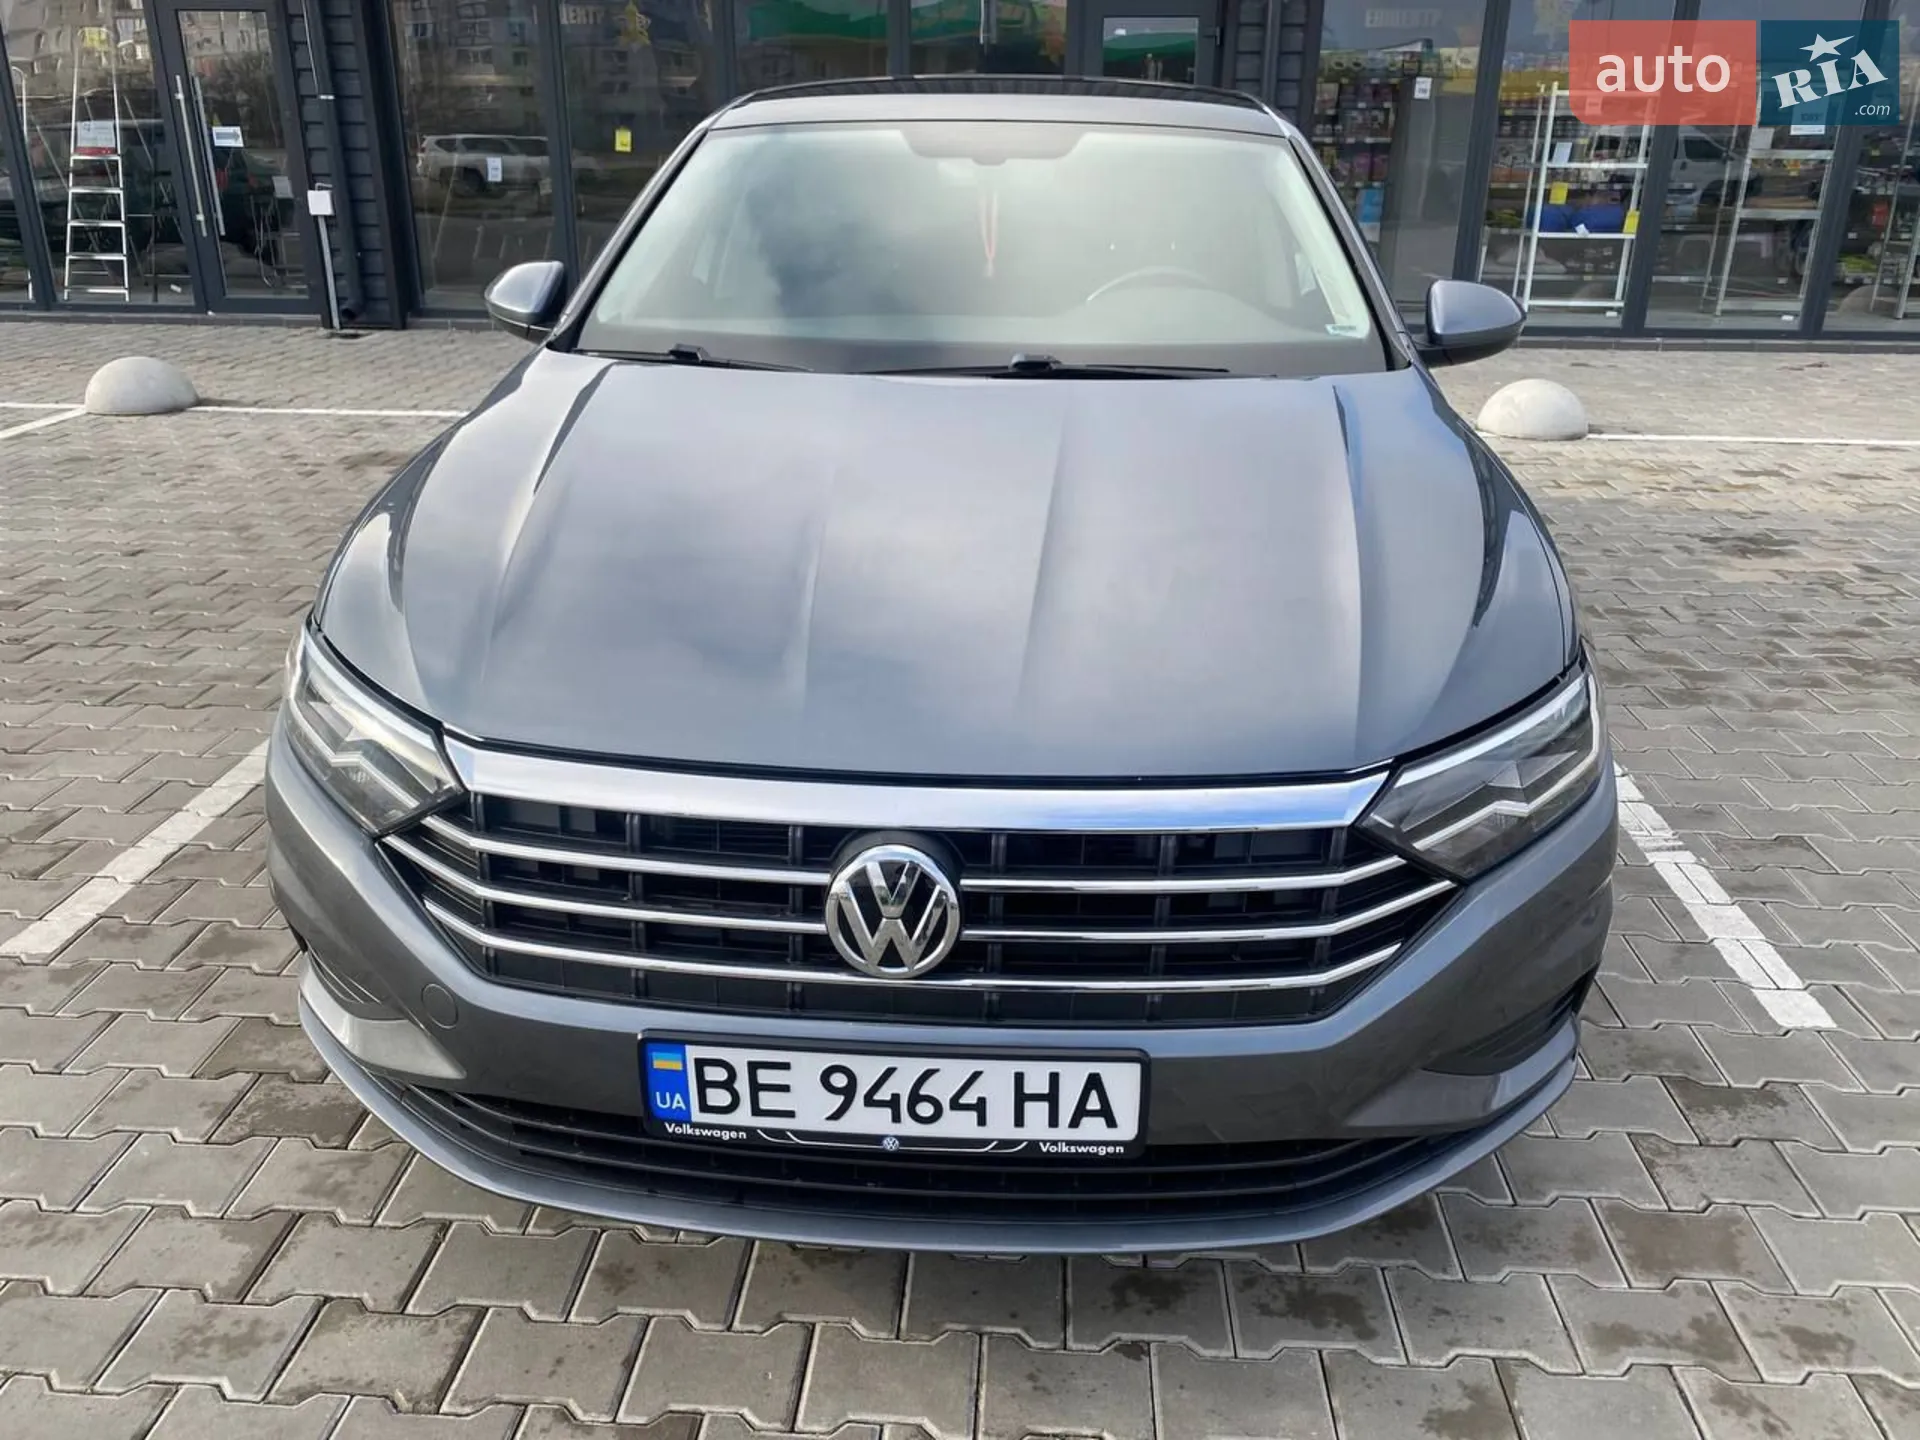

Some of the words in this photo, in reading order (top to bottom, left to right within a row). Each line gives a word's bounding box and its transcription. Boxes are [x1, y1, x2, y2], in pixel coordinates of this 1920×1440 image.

[656, 1091, 686, 1110] UA
[694, 1057, 796, 1118] BE
[820, 1064, 987, 1126] 9464
[1013, 1071, 1118, 1129] HA
[665, 1123, 747, 1140] Volkswagen
[1039, 1142, 1124, 1156] Volkswagen
